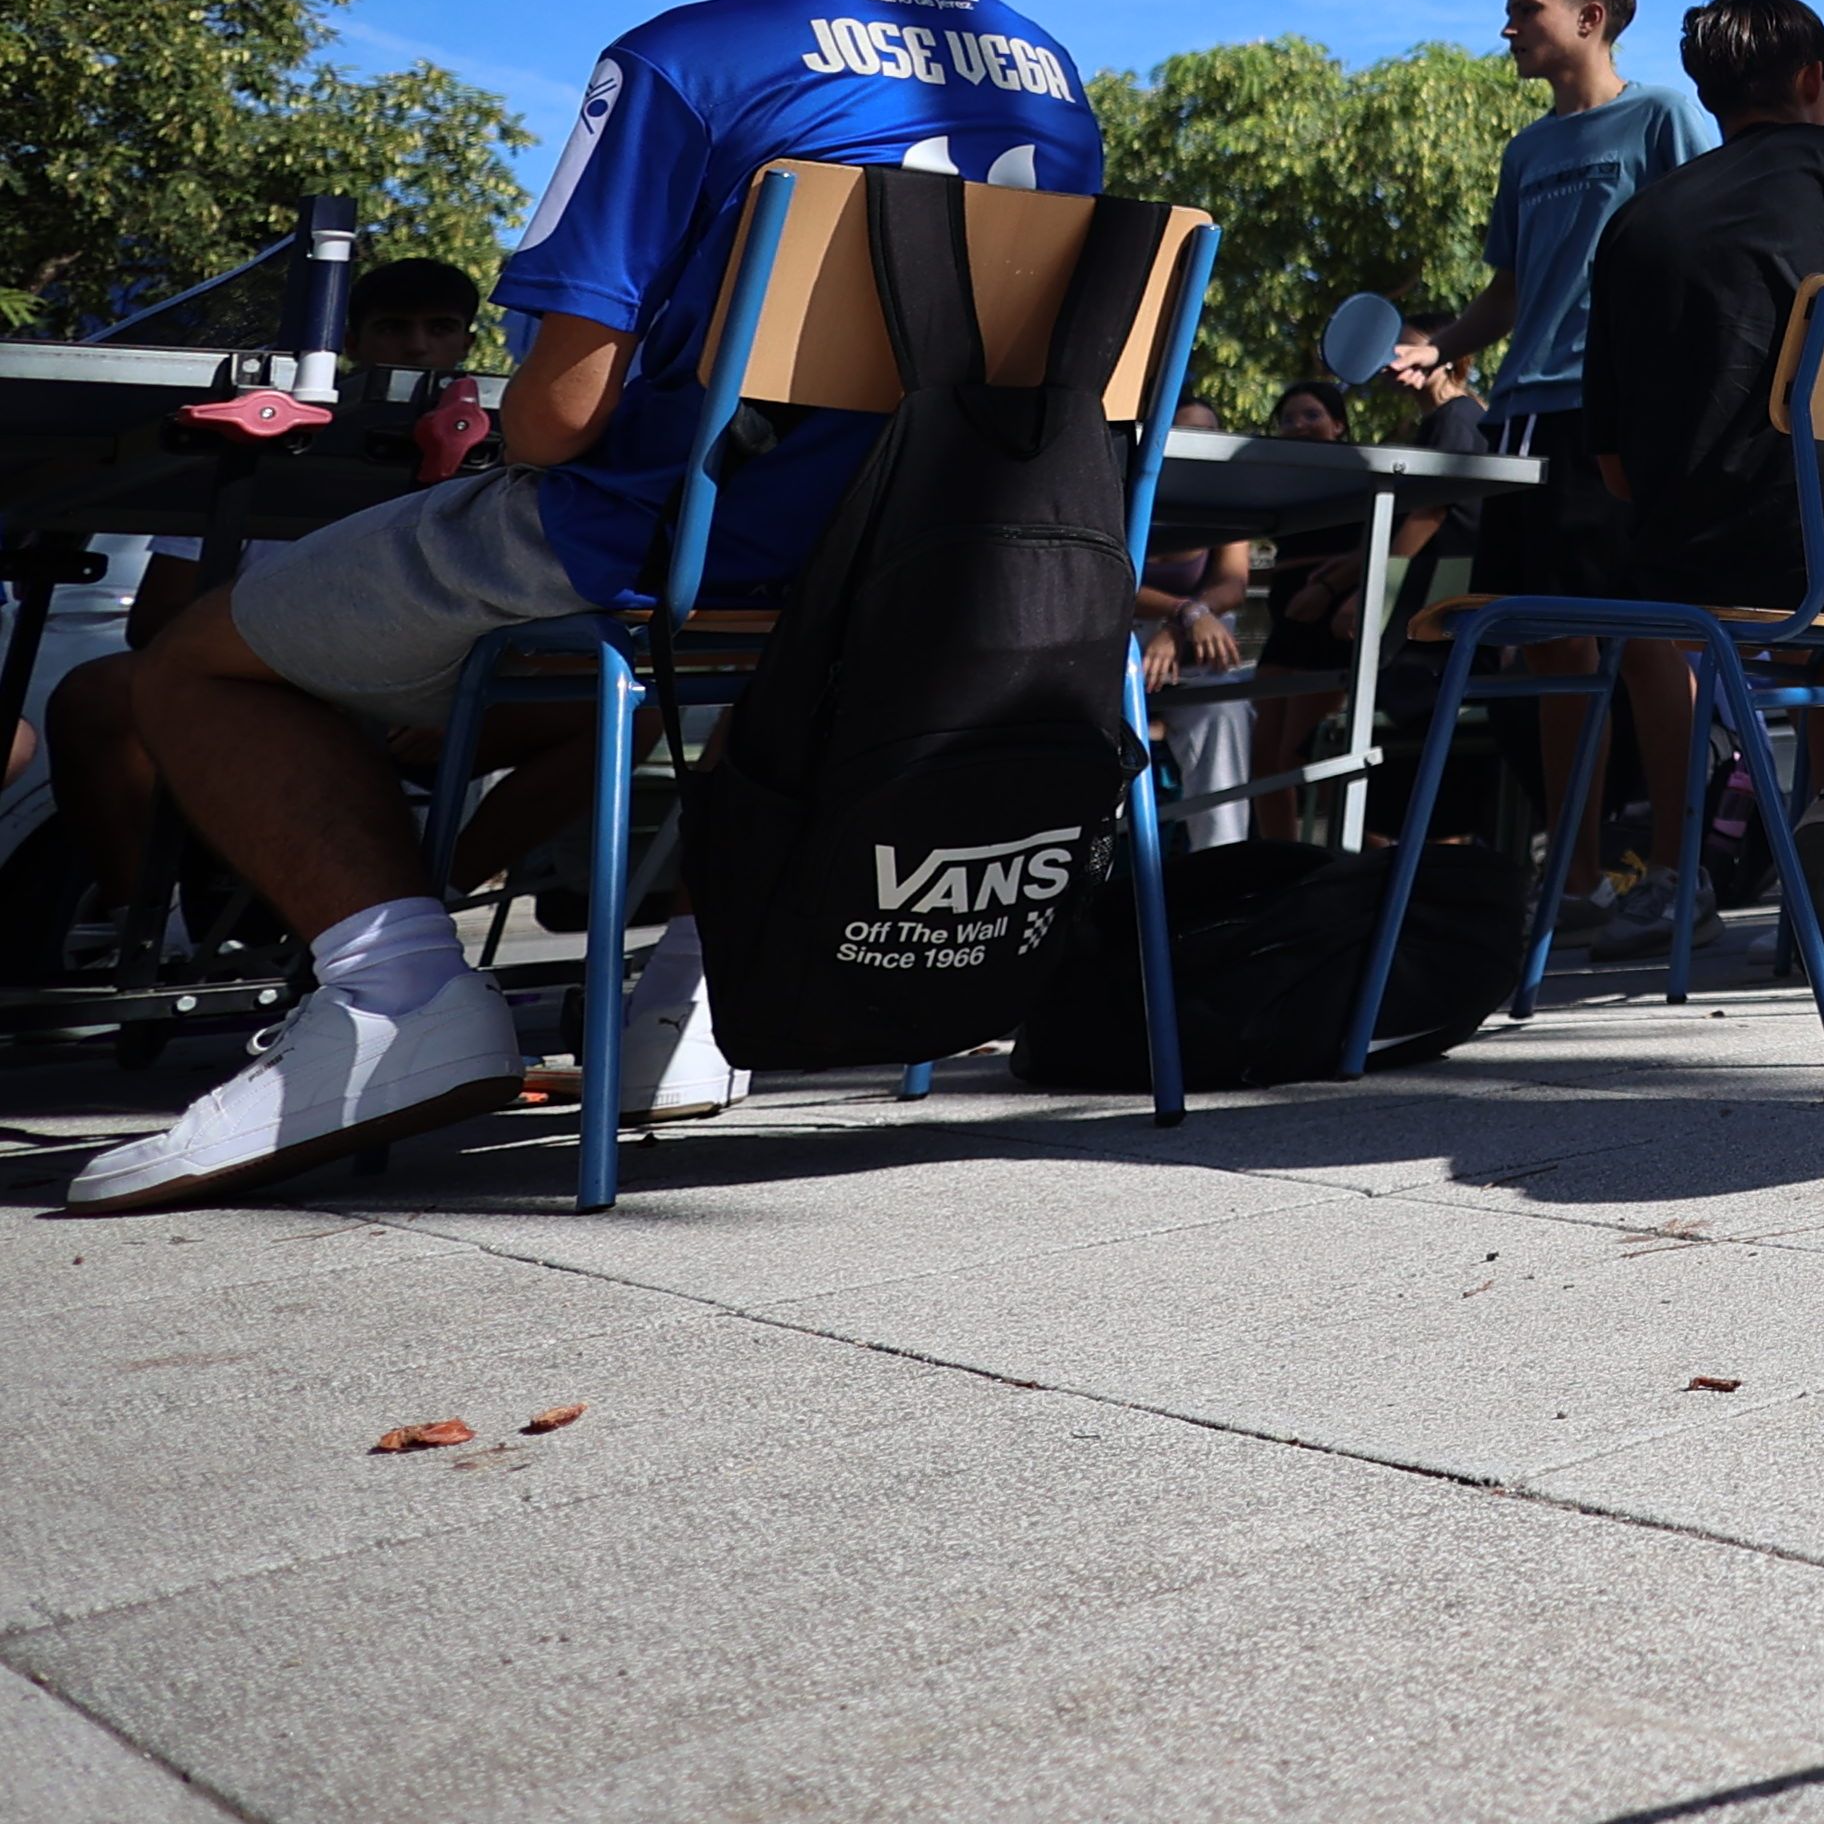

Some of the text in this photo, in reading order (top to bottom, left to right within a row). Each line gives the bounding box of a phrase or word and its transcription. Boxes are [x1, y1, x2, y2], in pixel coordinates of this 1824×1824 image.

[802, 17, 1076, 104] JOSE VEGA
[874, 825, 1082, 914] VANS
[836, 942, 986, 969] Since 1966
[844, 916, 1008, 944] Off The Wall
